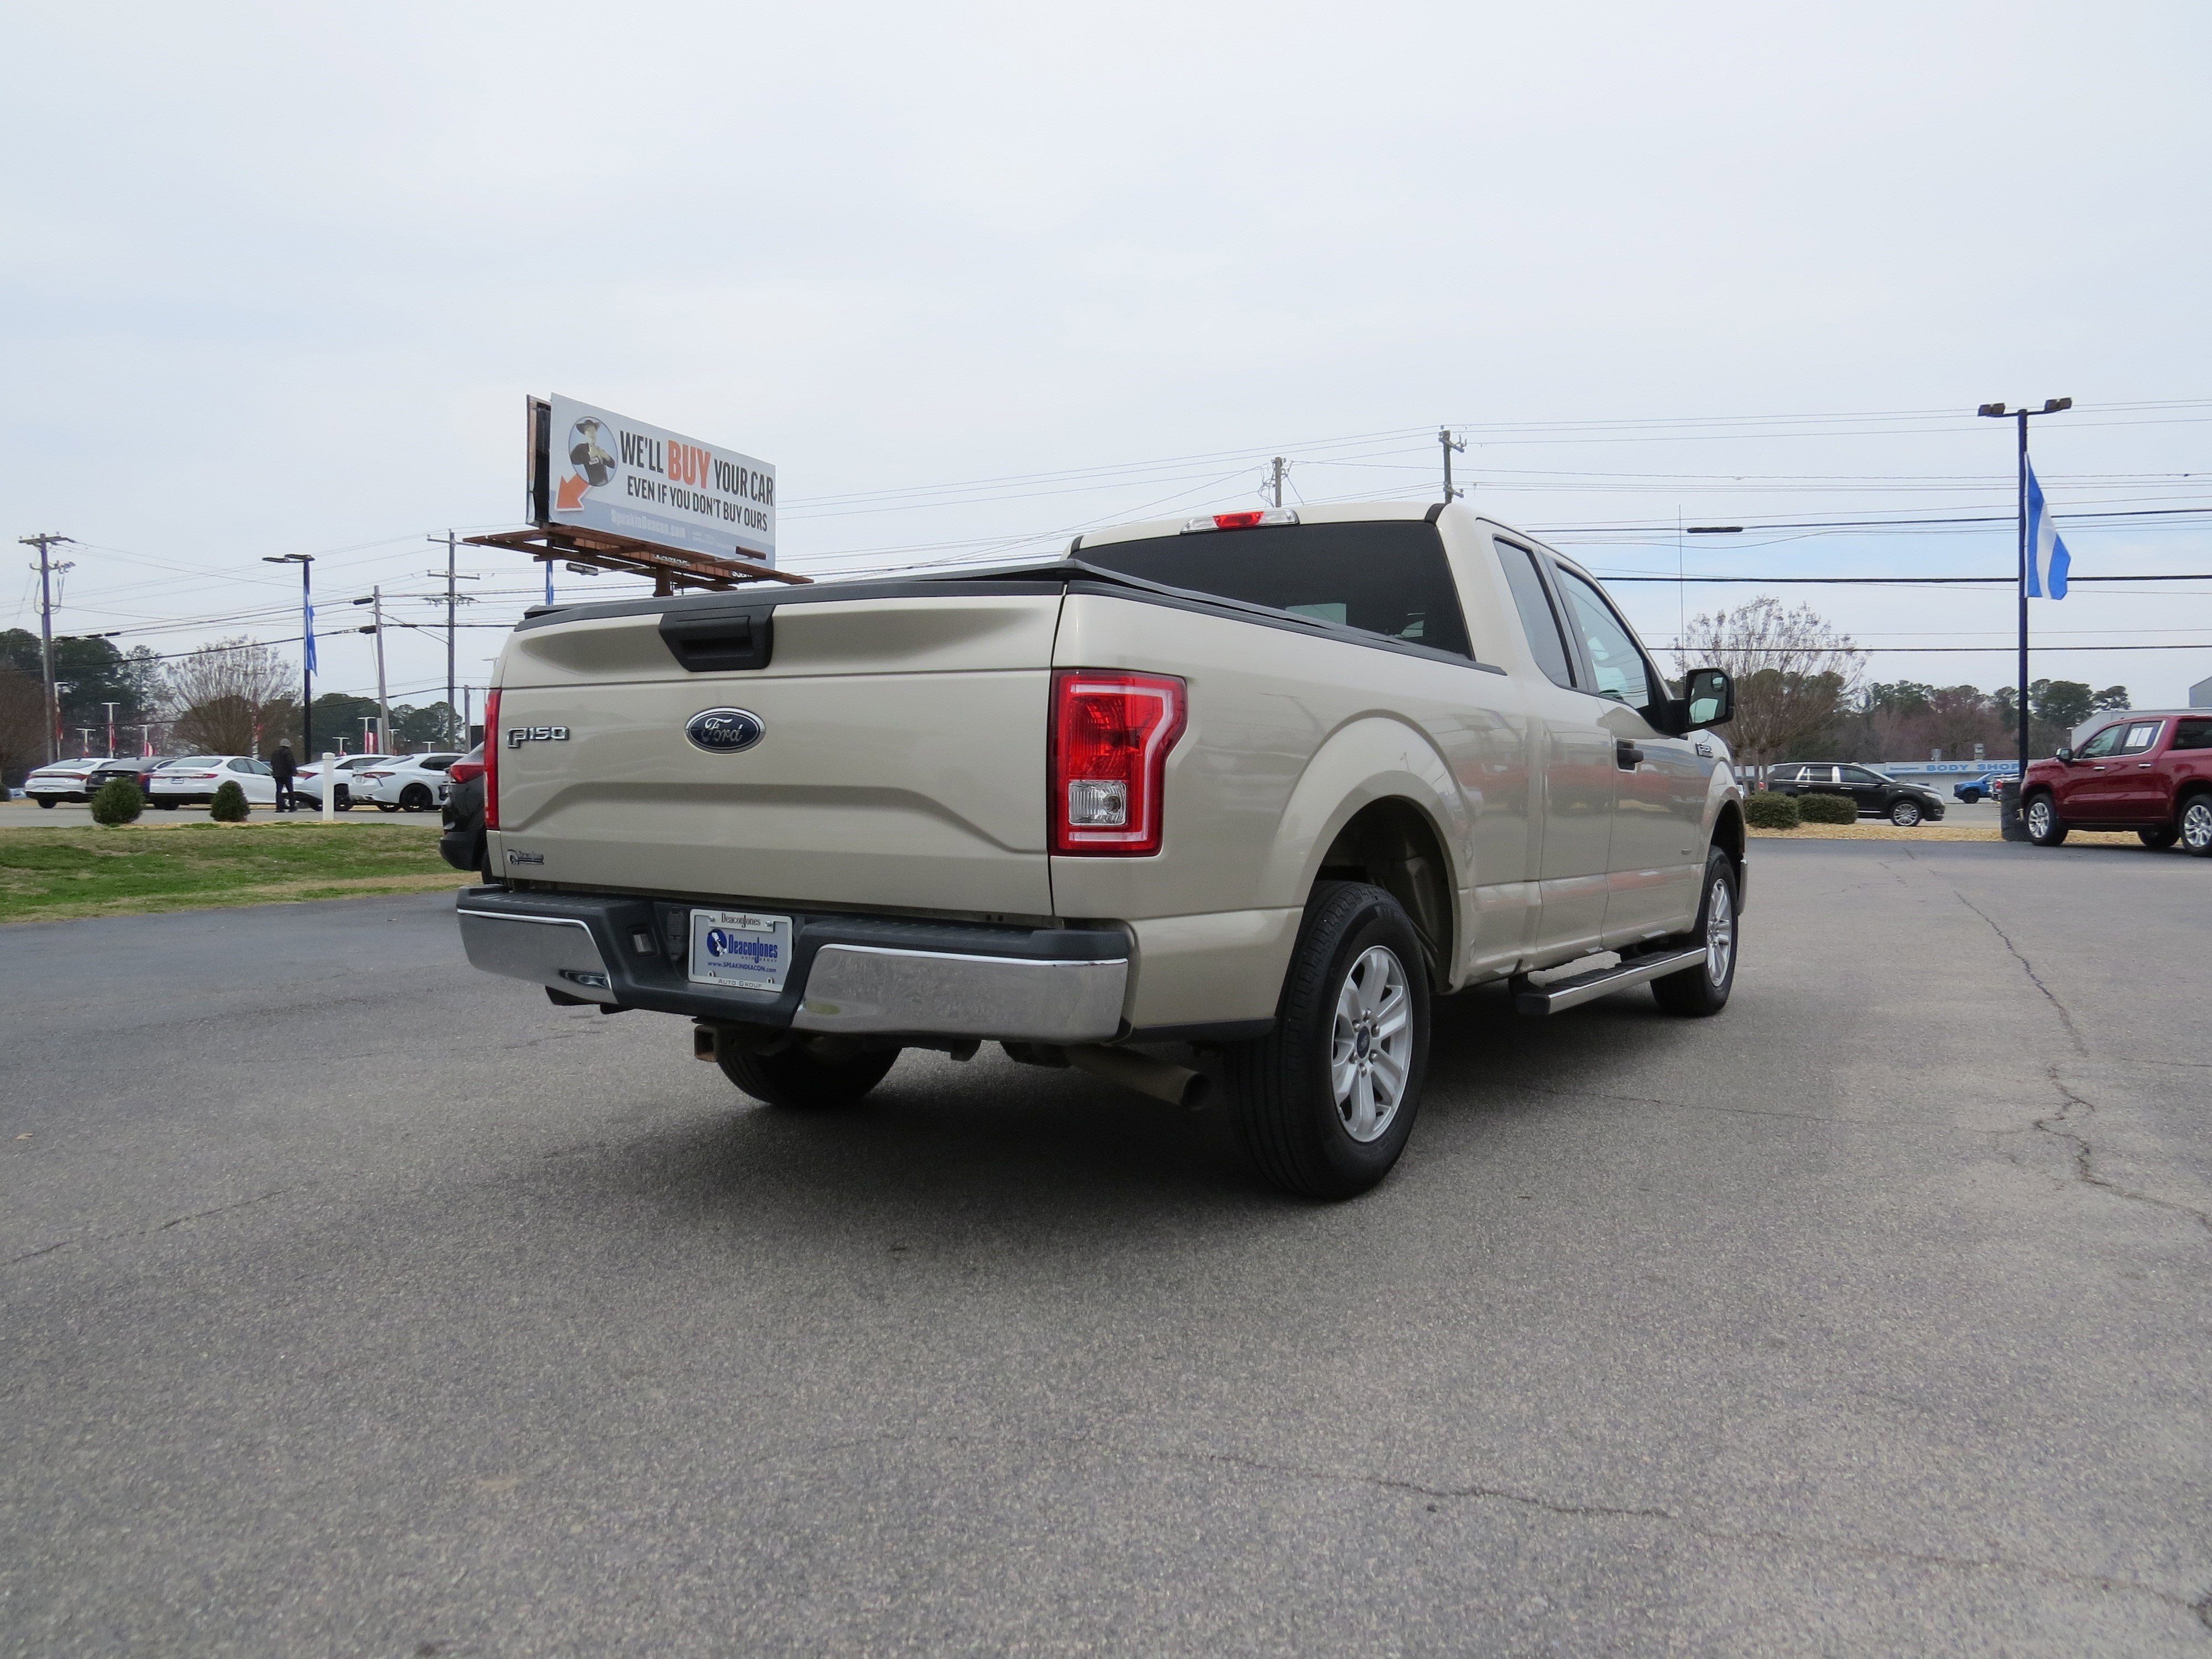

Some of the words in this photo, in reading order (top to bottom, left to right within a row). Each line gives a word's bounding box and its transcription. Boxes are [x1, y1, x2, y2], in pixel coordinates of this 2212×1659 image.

[620, 430, 664, 474] WE'LL
[667, 440, 711, 489] BUY
[713, 458, 748, 498] YOUR
[750, 471, 774, 507] CAR
[627, 474, 655, 501] EVEN
[658, 482, 667, 504] IF
[669, 486, 690, 510] YOU
[692, 492, 722, 519] DON'T
[723, 500, 742, 524] BUY
[744, 507, 768, 531] OURS
[508, 726, 569, 749] F150
[701, 717, 743, 742] Ford
